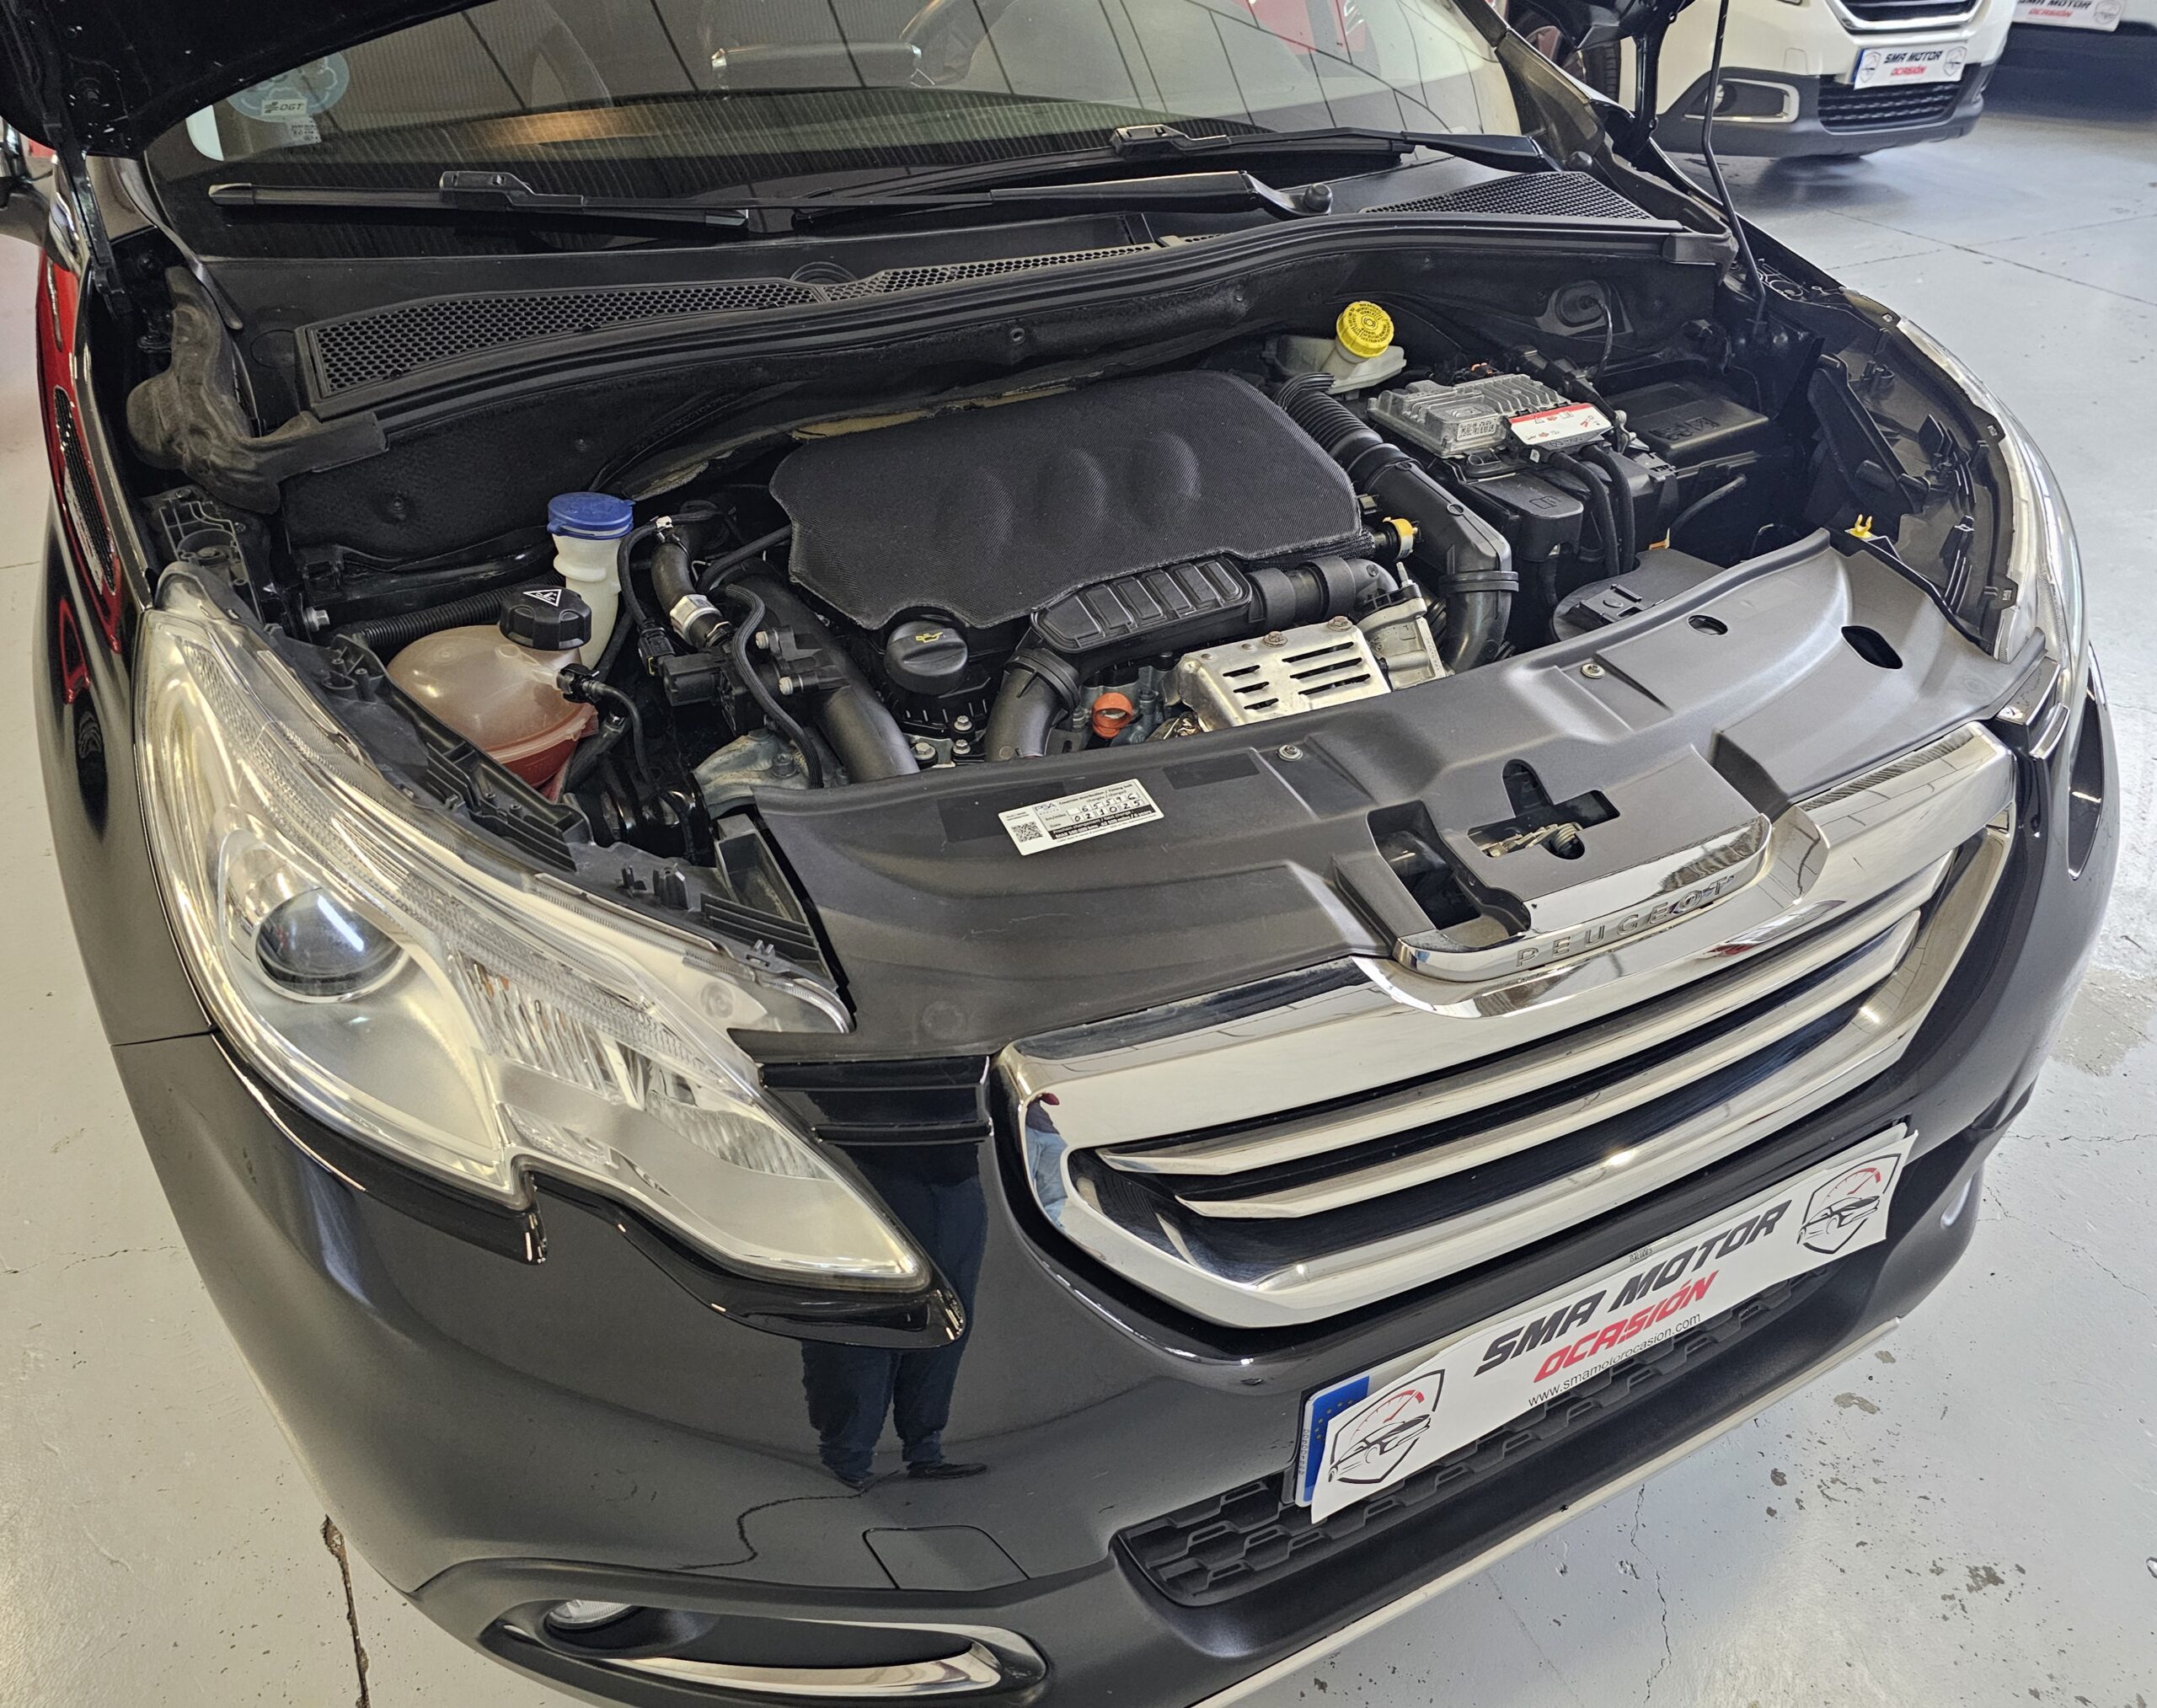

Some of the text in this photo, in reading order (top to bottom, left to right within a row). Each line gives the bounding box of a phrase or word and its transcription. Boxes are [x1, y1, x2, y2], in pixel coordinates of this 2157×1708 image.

[1883, 50, 1944, 64] SMA MOTOR
[1890, 64, 1928, 76] OCASIÓN
[1516, 875, 1736, 967] PEUGEOT
[1474, 1199, 1792, 1377] SMA MOTOR
[1533, 1270, 1719, 1383] OCASIÓN
[1528, 1313, 1701, 1407] www.smamotorocasion.com
